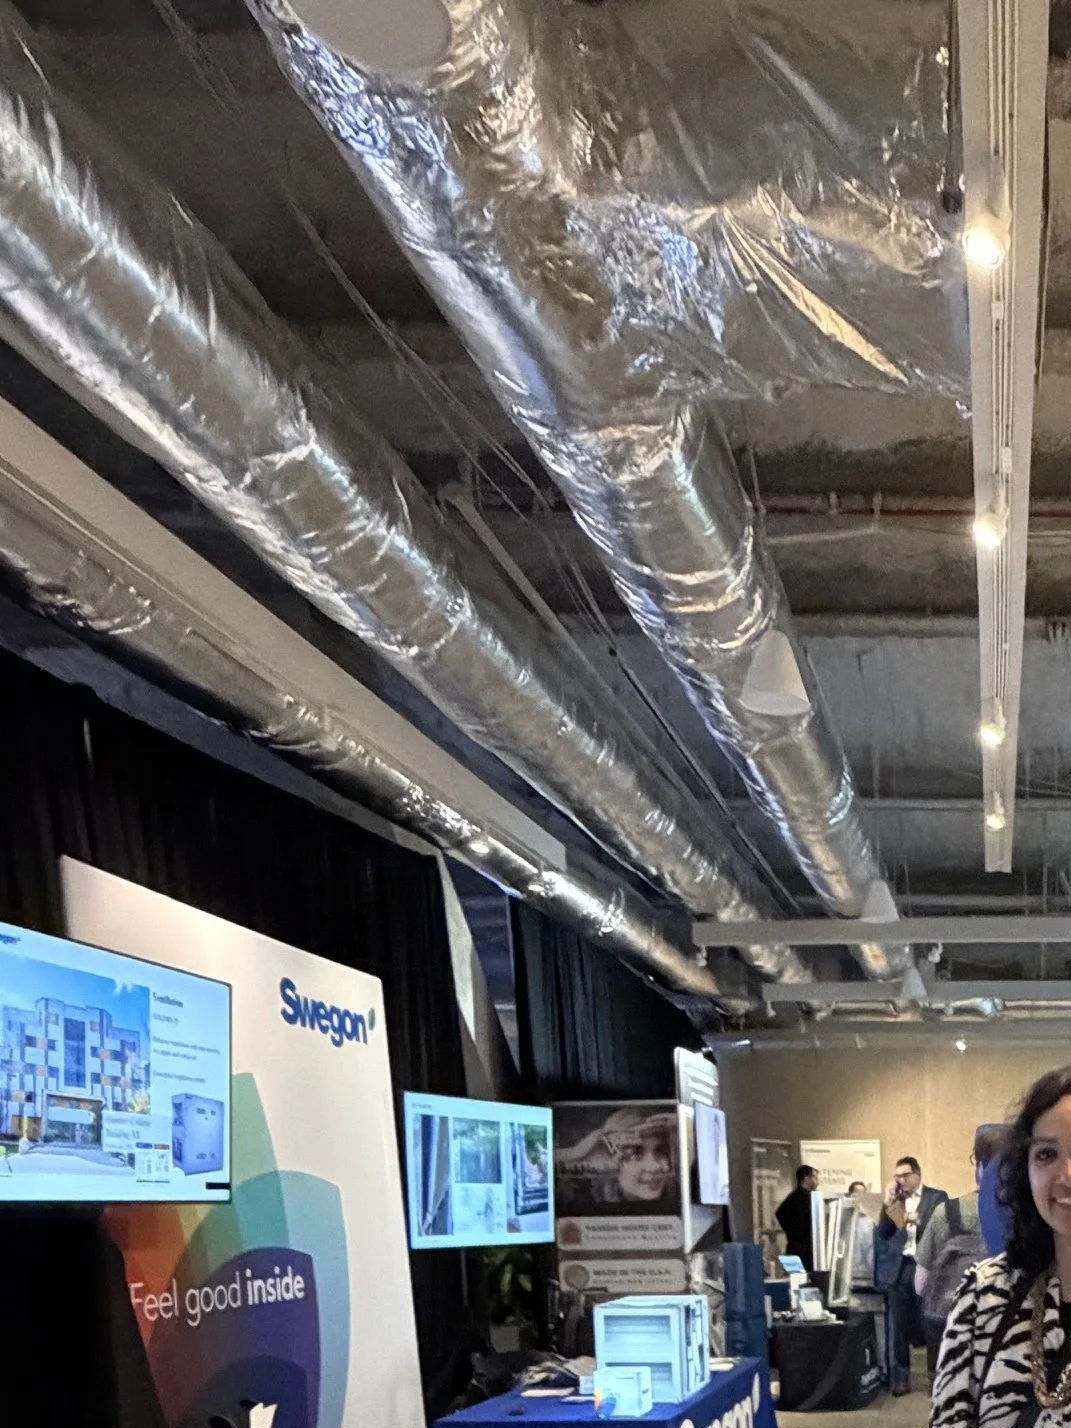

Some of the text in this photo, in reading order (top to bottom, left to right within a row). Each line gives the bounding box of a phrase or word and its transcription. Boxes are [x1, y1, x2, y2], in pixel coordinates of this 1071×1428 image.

[280, 977, 367, 1047] Swegon
[129, 1265, 305, 1327] Feel good inside
